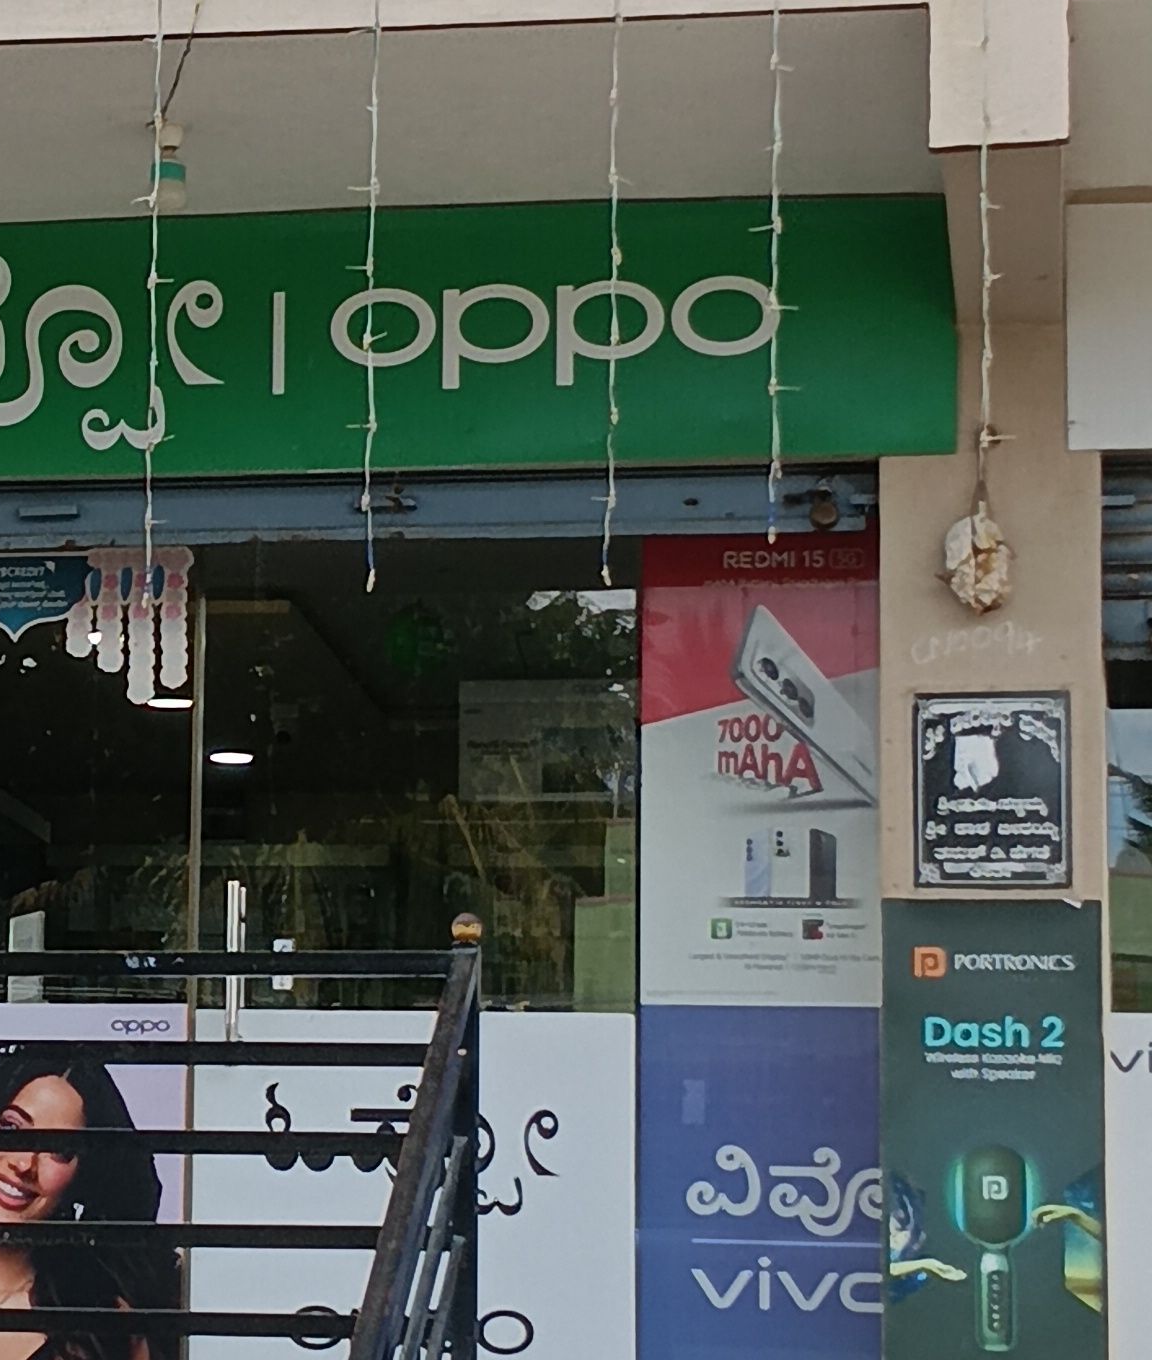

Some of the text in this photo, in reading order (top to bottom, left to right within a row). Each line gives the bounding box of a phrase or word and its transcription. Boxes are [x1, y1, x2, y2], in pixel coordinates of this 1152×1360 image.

[330, 275, 780, 391] oppo
[722, 550, 796, 569] REDMI
[802, 550, 825, 569] 15
[717, 714, 786, 744] 7000
[954, 953, 1077, 972] PORTRONICS
[111, 1020, 170, 1035] oppo
[923, 1016, 1066, 1049] Dash 2
